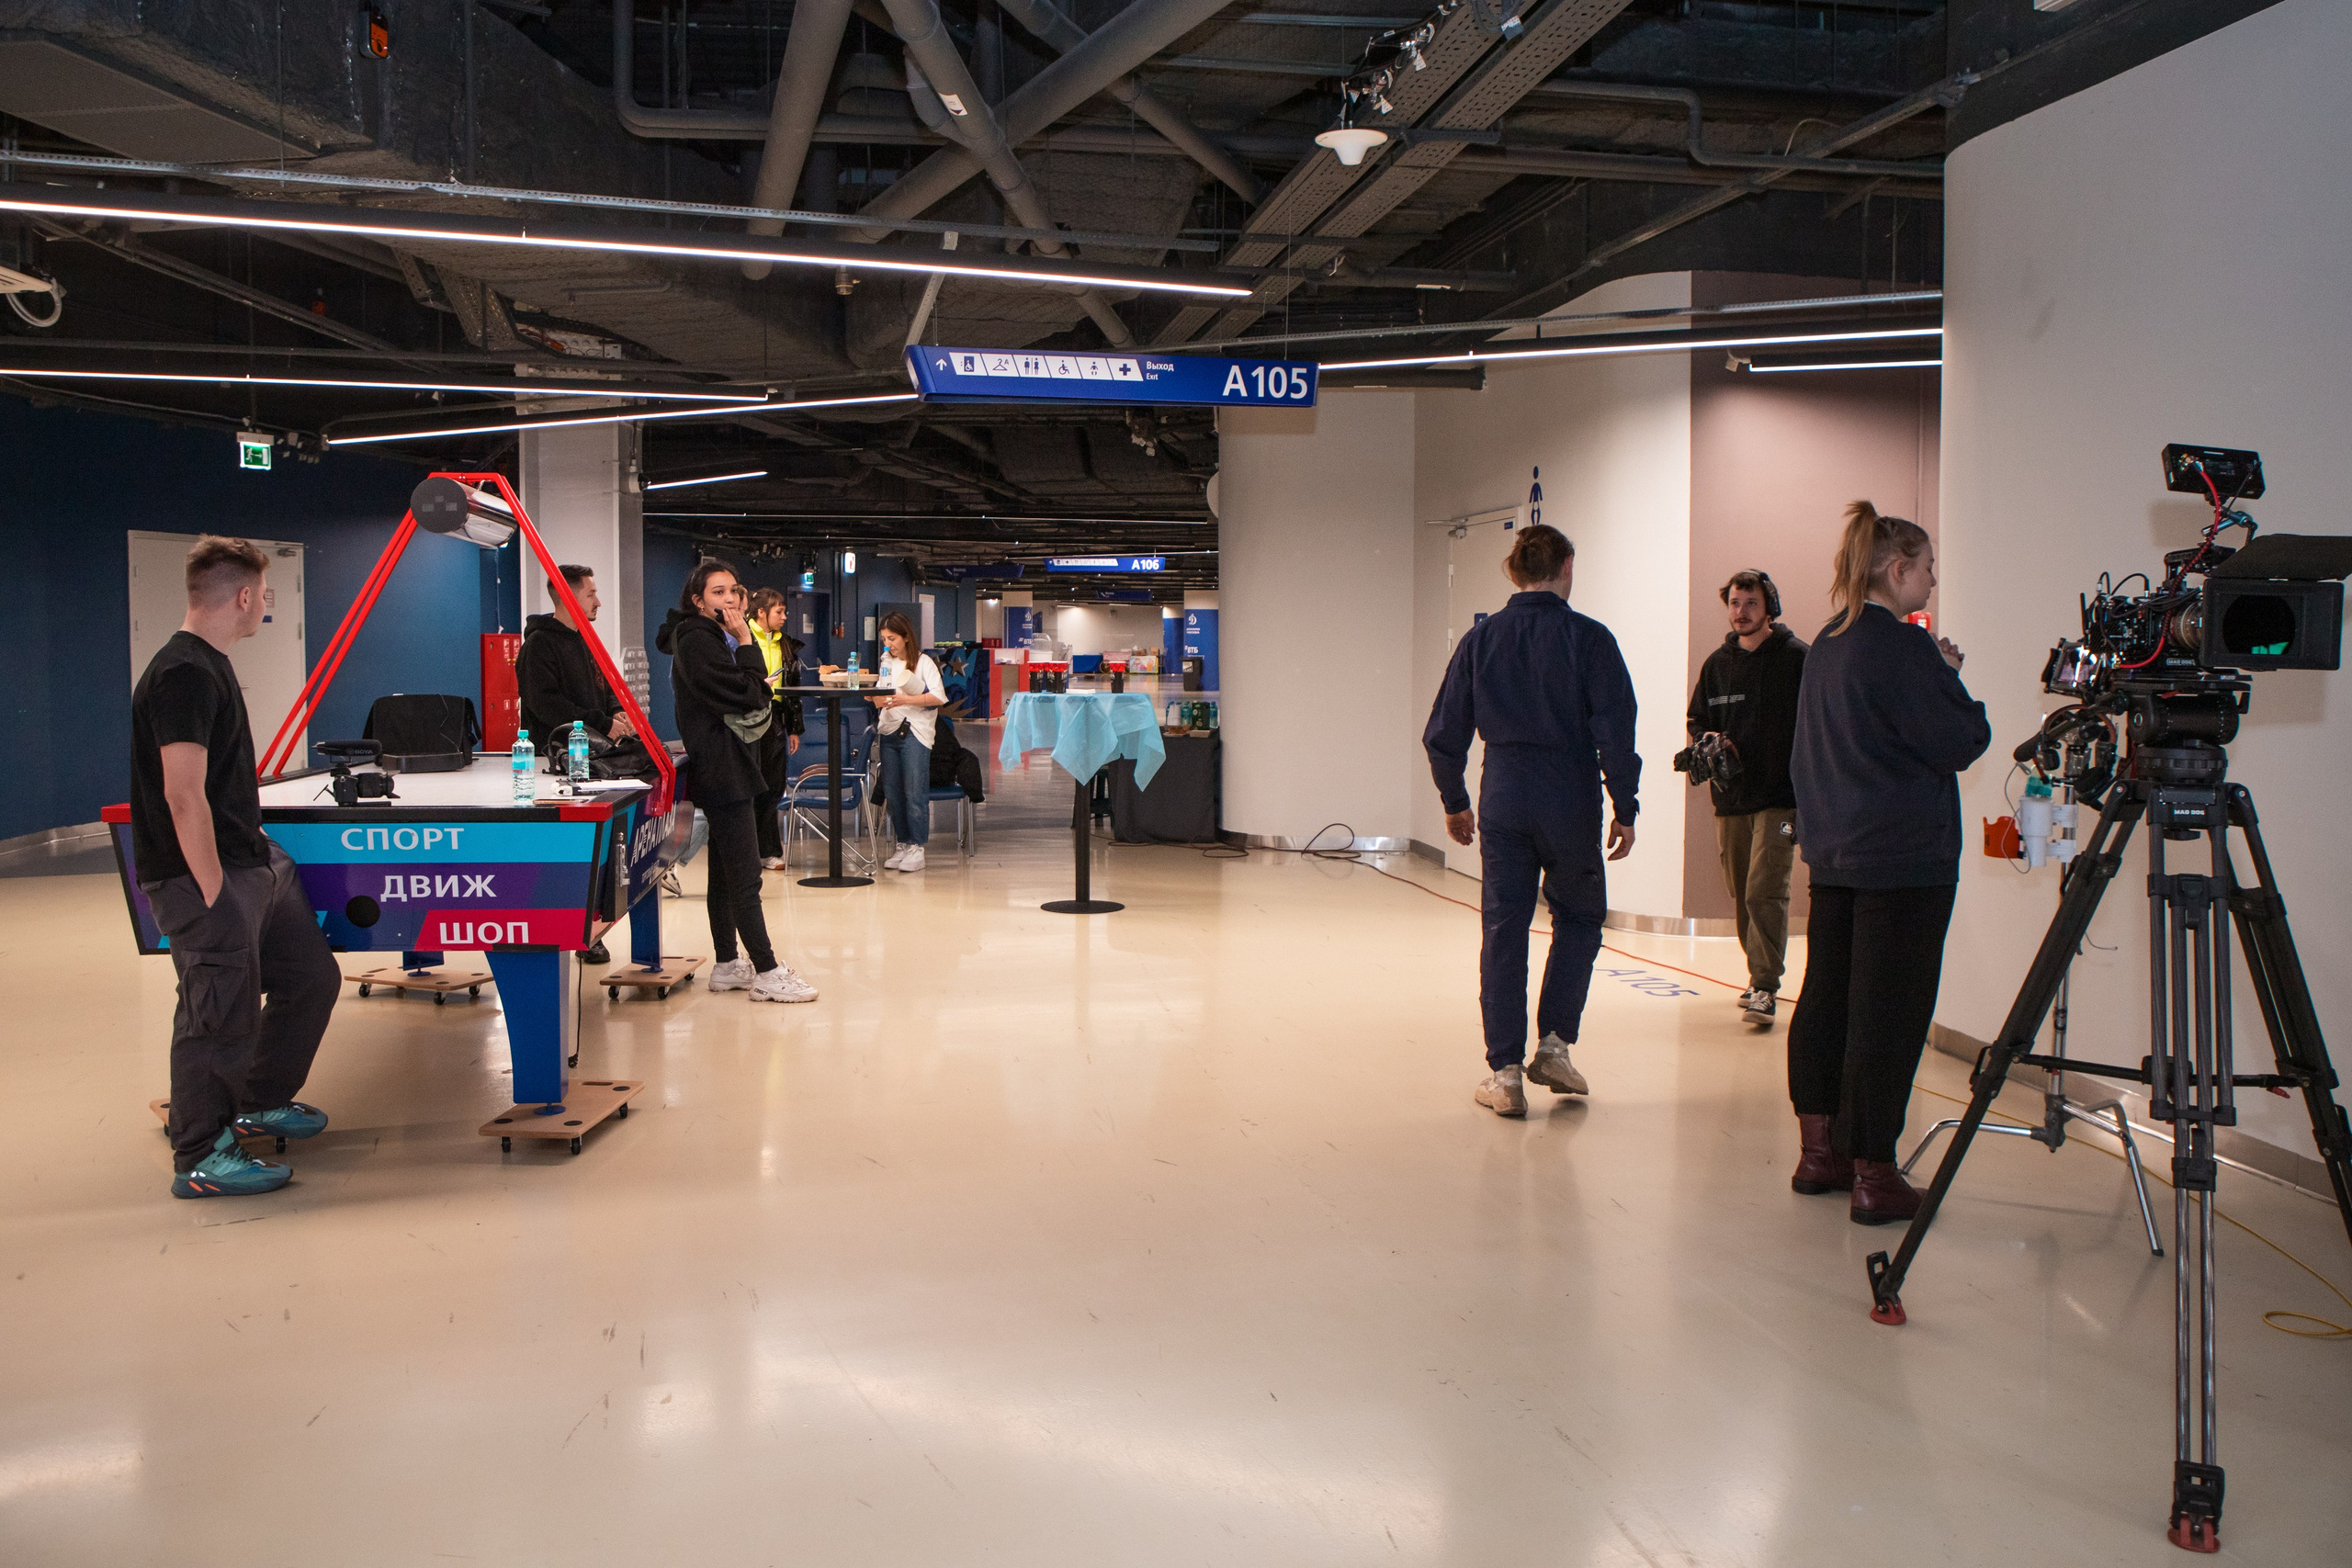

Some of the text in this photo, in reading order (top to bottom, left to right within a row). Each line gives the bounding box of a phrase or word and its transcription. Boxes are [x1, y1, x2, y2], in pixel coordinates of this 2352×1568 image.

[1146, 361, 1175, 372] Выход
[1146, 372, 1159, 380] Exit
[1222, 364, 1308, 400] A105
[1131, 559, 1159, 570] A106
[341, 828, 465, 851] СПОРТ
[380, 874, 497, 903] ДВИЖ
[439, 921, 529, 944] ШОП
[1594, 968, 1701, 997] A105
